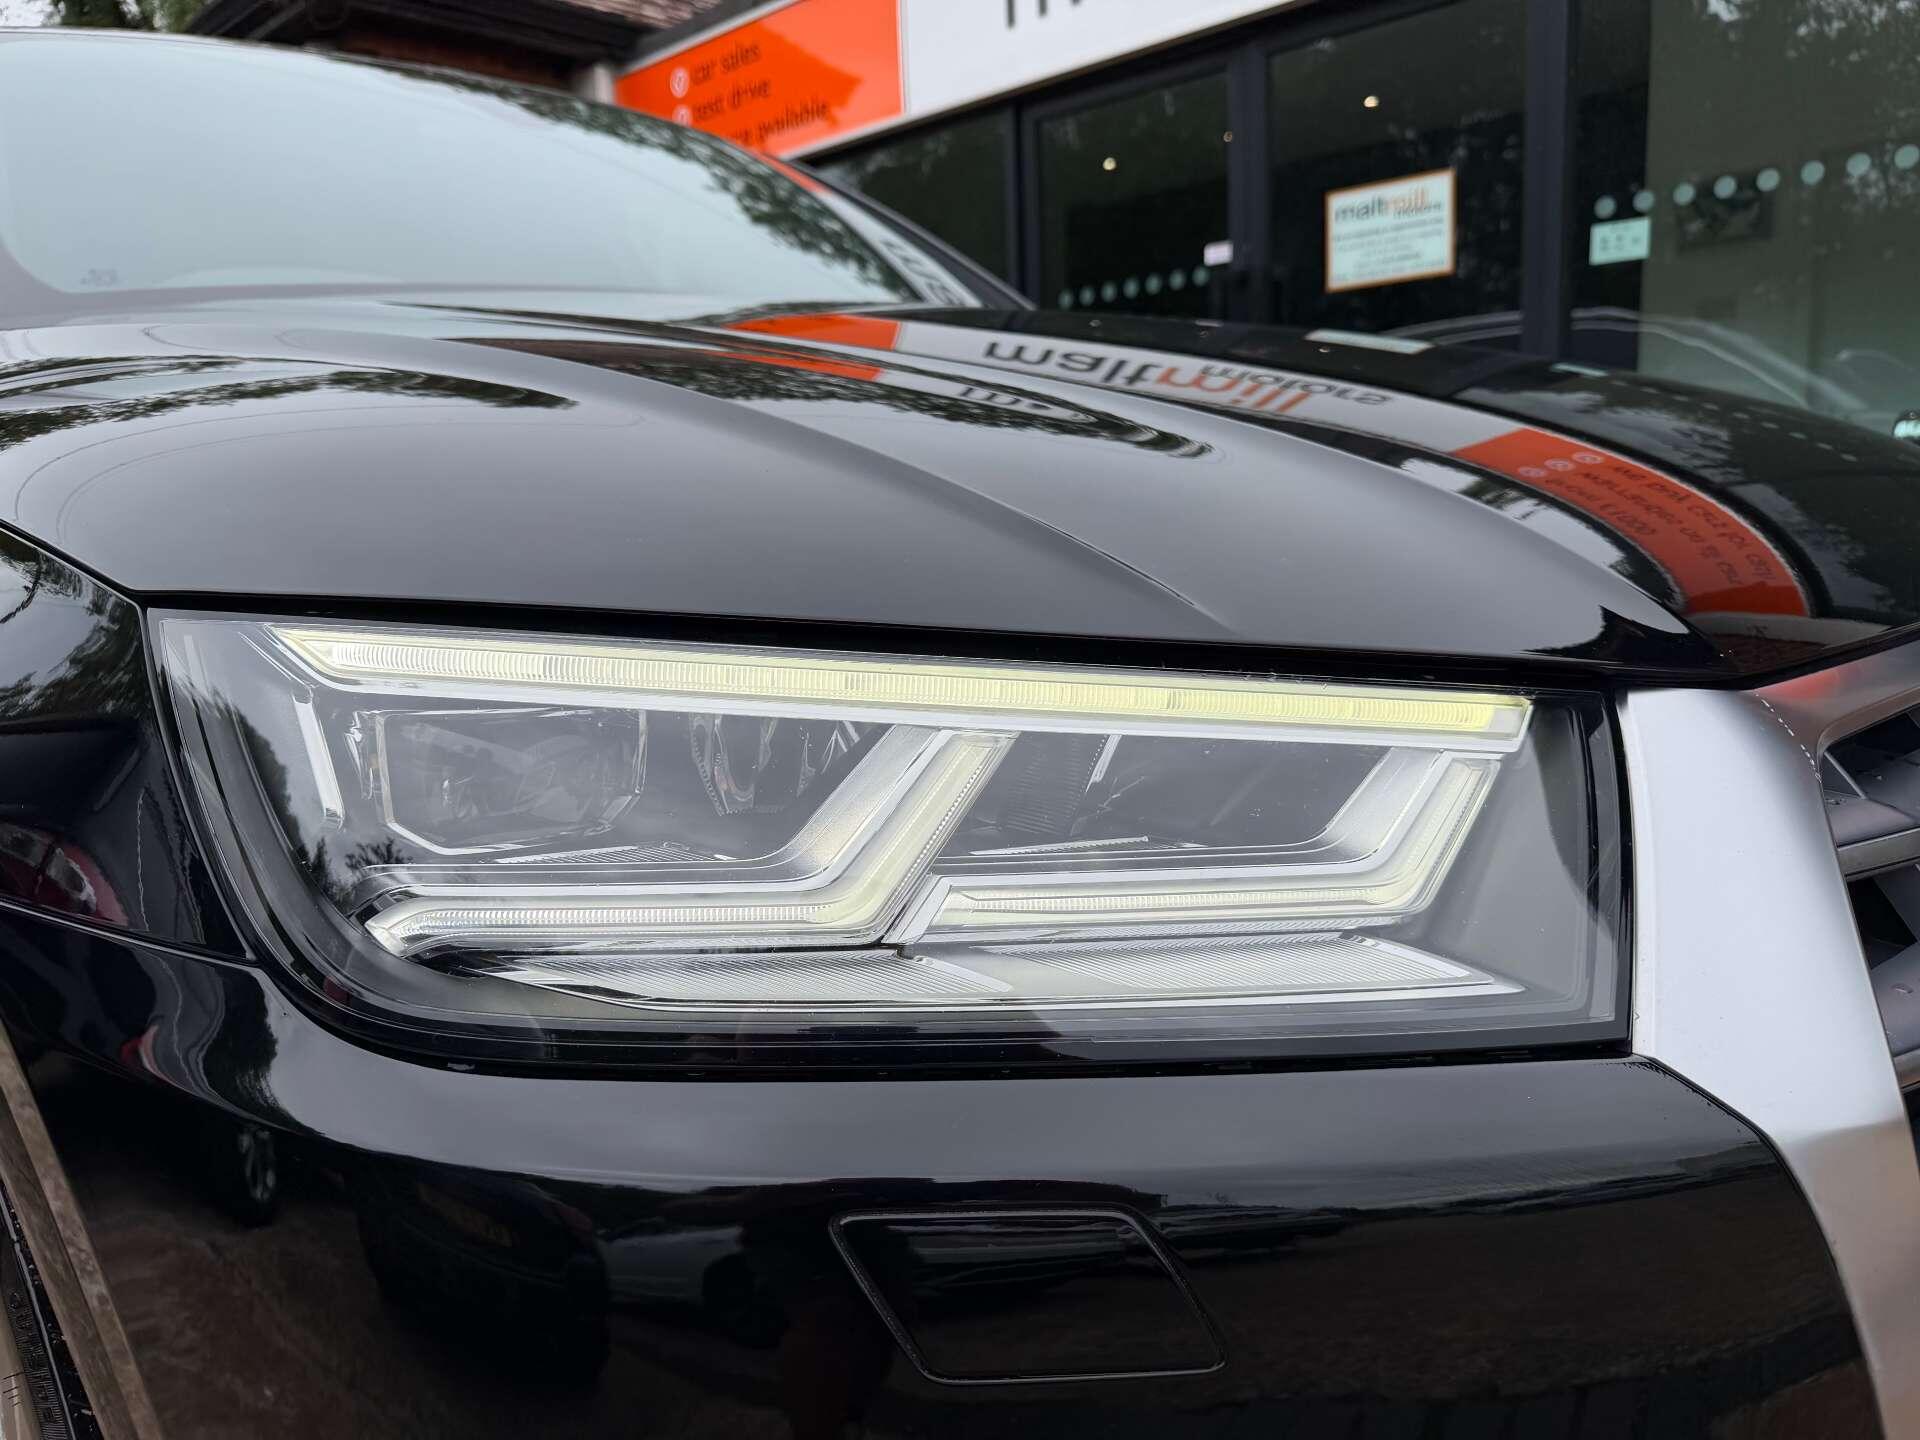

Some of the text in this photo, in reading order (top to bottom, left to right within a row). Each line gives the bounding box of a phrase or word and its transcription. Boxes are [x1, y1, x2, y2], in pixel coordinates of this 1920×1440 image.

[691, 41, 760, 84] car sales
[731, 78, 770, 109] drive
[757, 99, 831, 140] available
